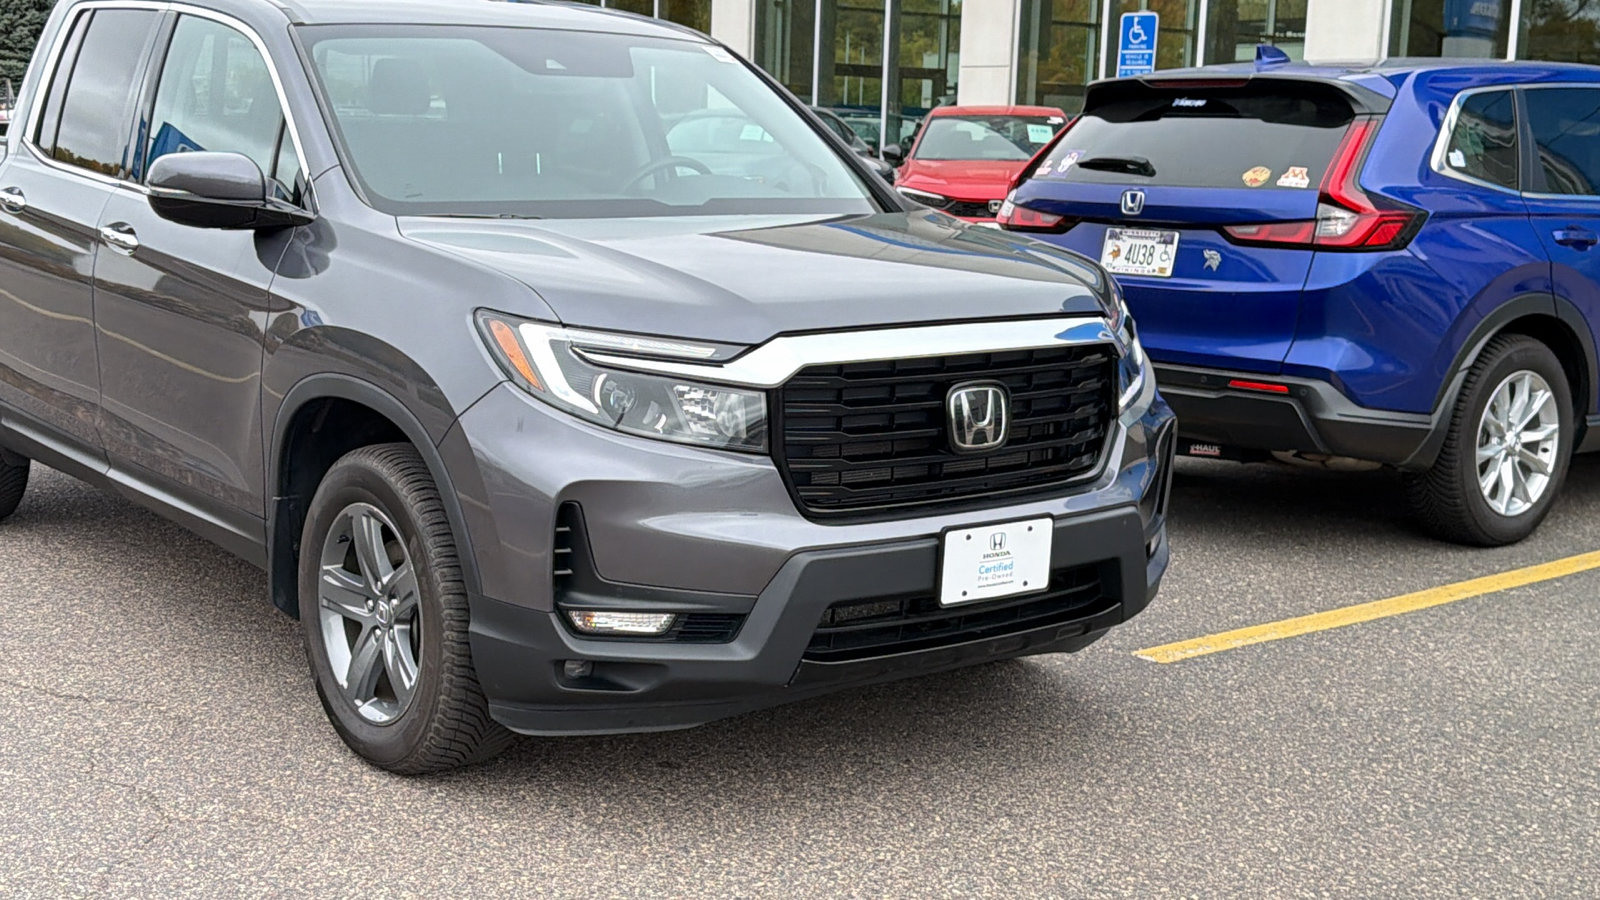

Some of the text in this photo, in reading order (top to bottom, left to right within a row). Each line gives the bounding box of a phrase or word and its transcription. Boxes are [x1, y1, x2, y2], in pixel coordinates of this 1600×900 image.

[1124, 243, 1156, 266] 4U38
[982, 550, 1011, 559] HONDA
[978, 560, 1014, 575] Certified
[977, 572, 1013, 582] Pre-Owned
